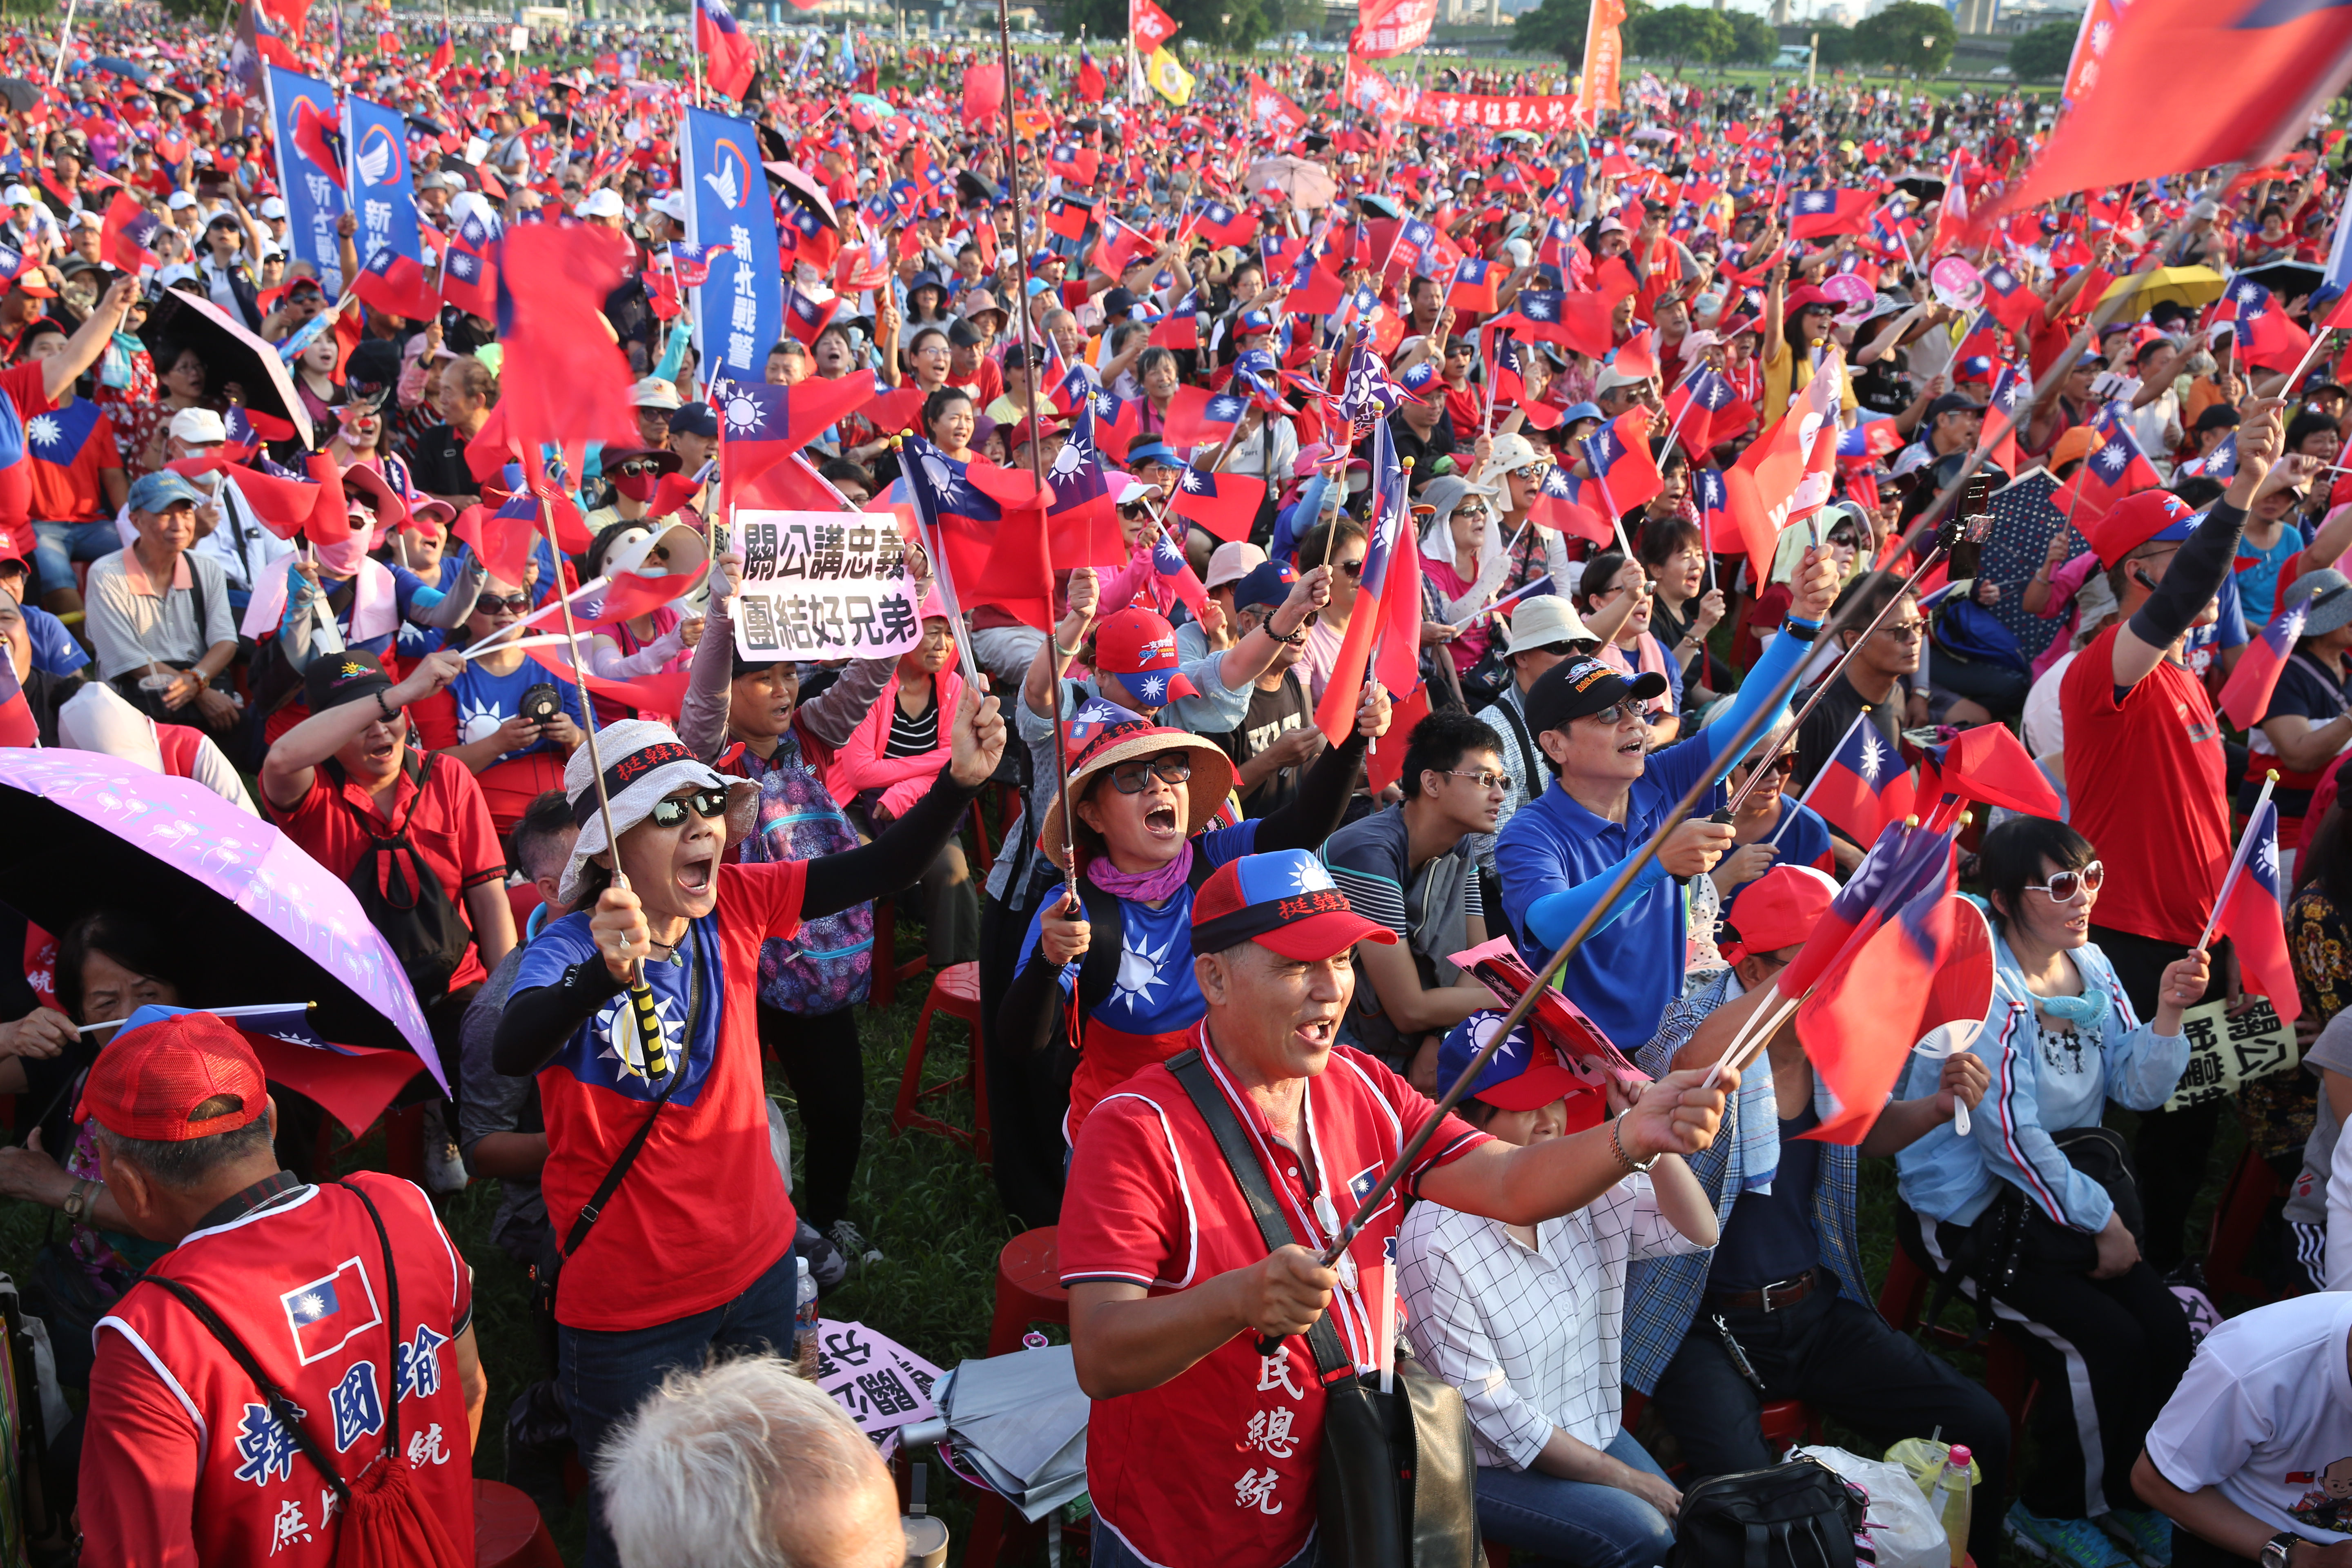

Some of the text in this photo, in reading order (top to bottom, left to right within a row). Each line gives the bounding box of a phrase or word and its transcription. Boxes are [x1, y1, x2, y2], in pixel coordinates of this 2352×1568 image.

[742, 523, 905, 581] 關公講忠義
[740, 593, 918, 650] 團結好兄弟
[617, 743, 699, 781] 挺韓到
[234, 1323, 450, 1487] 韓國瑜
[270, 1423, 450, 1557] 庶民統
